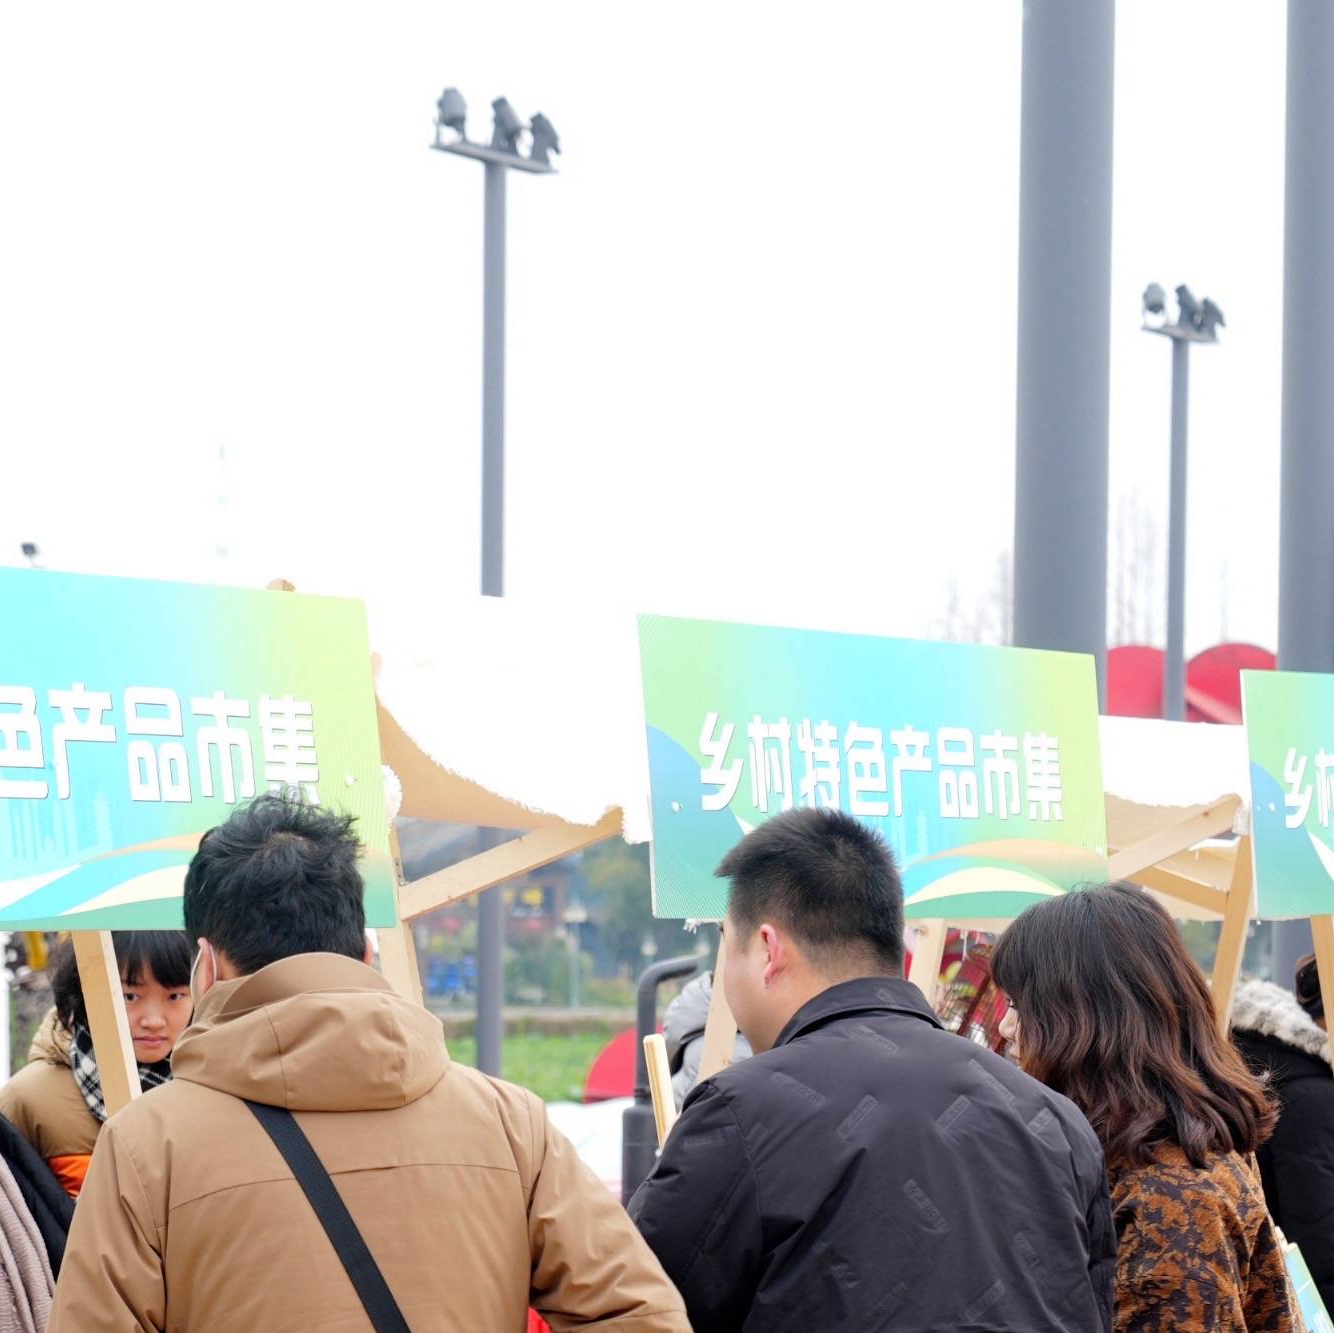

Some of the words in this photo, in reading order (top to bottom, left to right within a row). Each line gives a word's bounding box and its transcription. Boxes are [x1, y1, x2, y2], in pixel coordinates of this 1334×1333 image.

[699, 711, 1064, 822] 乡村特色产品市集
